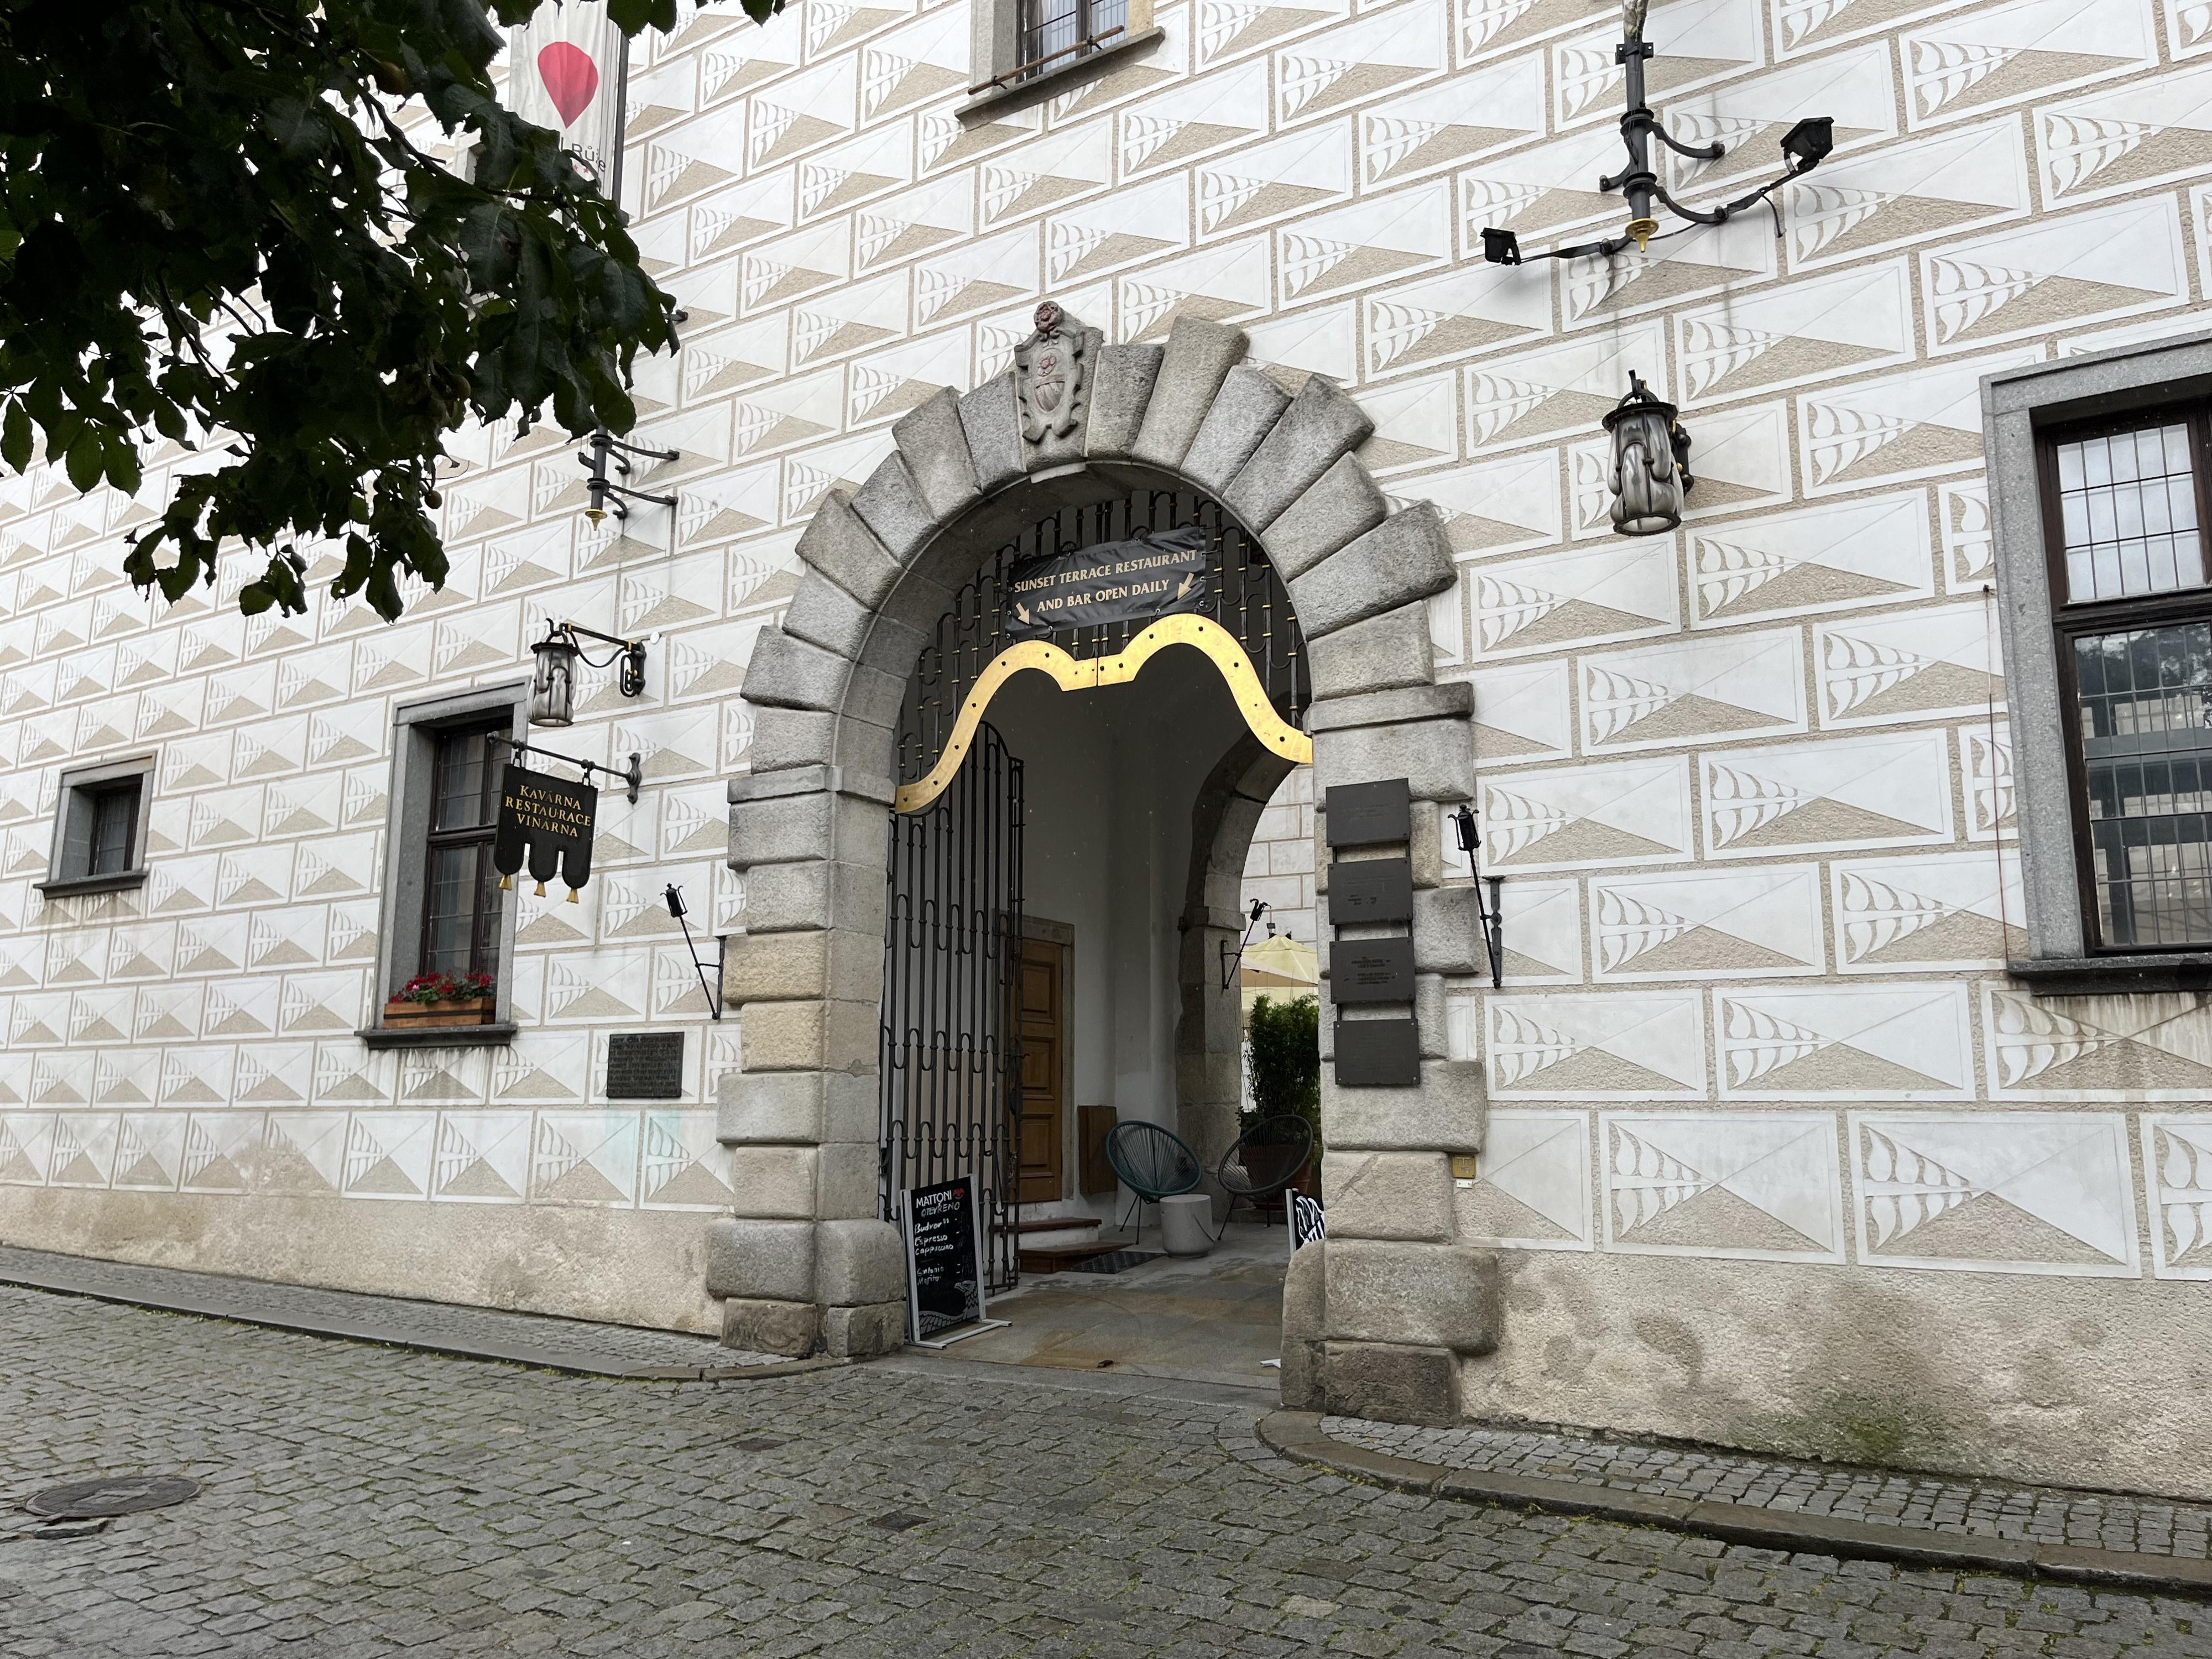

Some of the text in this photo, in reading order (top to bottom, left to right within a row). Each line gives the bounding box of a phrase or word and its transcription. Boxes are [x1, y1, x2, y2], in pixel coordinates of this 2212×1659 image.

[572, 143, 606, 173] Růe
[1014, 549, 1198, 593] SUNSET TERRACE RESTAURANT
[1037, 579, 1170, 612] AND BAR OPEN DAILY
[505, 796, 592, 827] RESTAURACE
[520, 784, 581, 811] KAVÁRNA
[517, 813, 578, 837] VINÁRNA
[916, 1190, 952, 1208] MATTONI
[914, 1234, 948, 1246] Espresso
